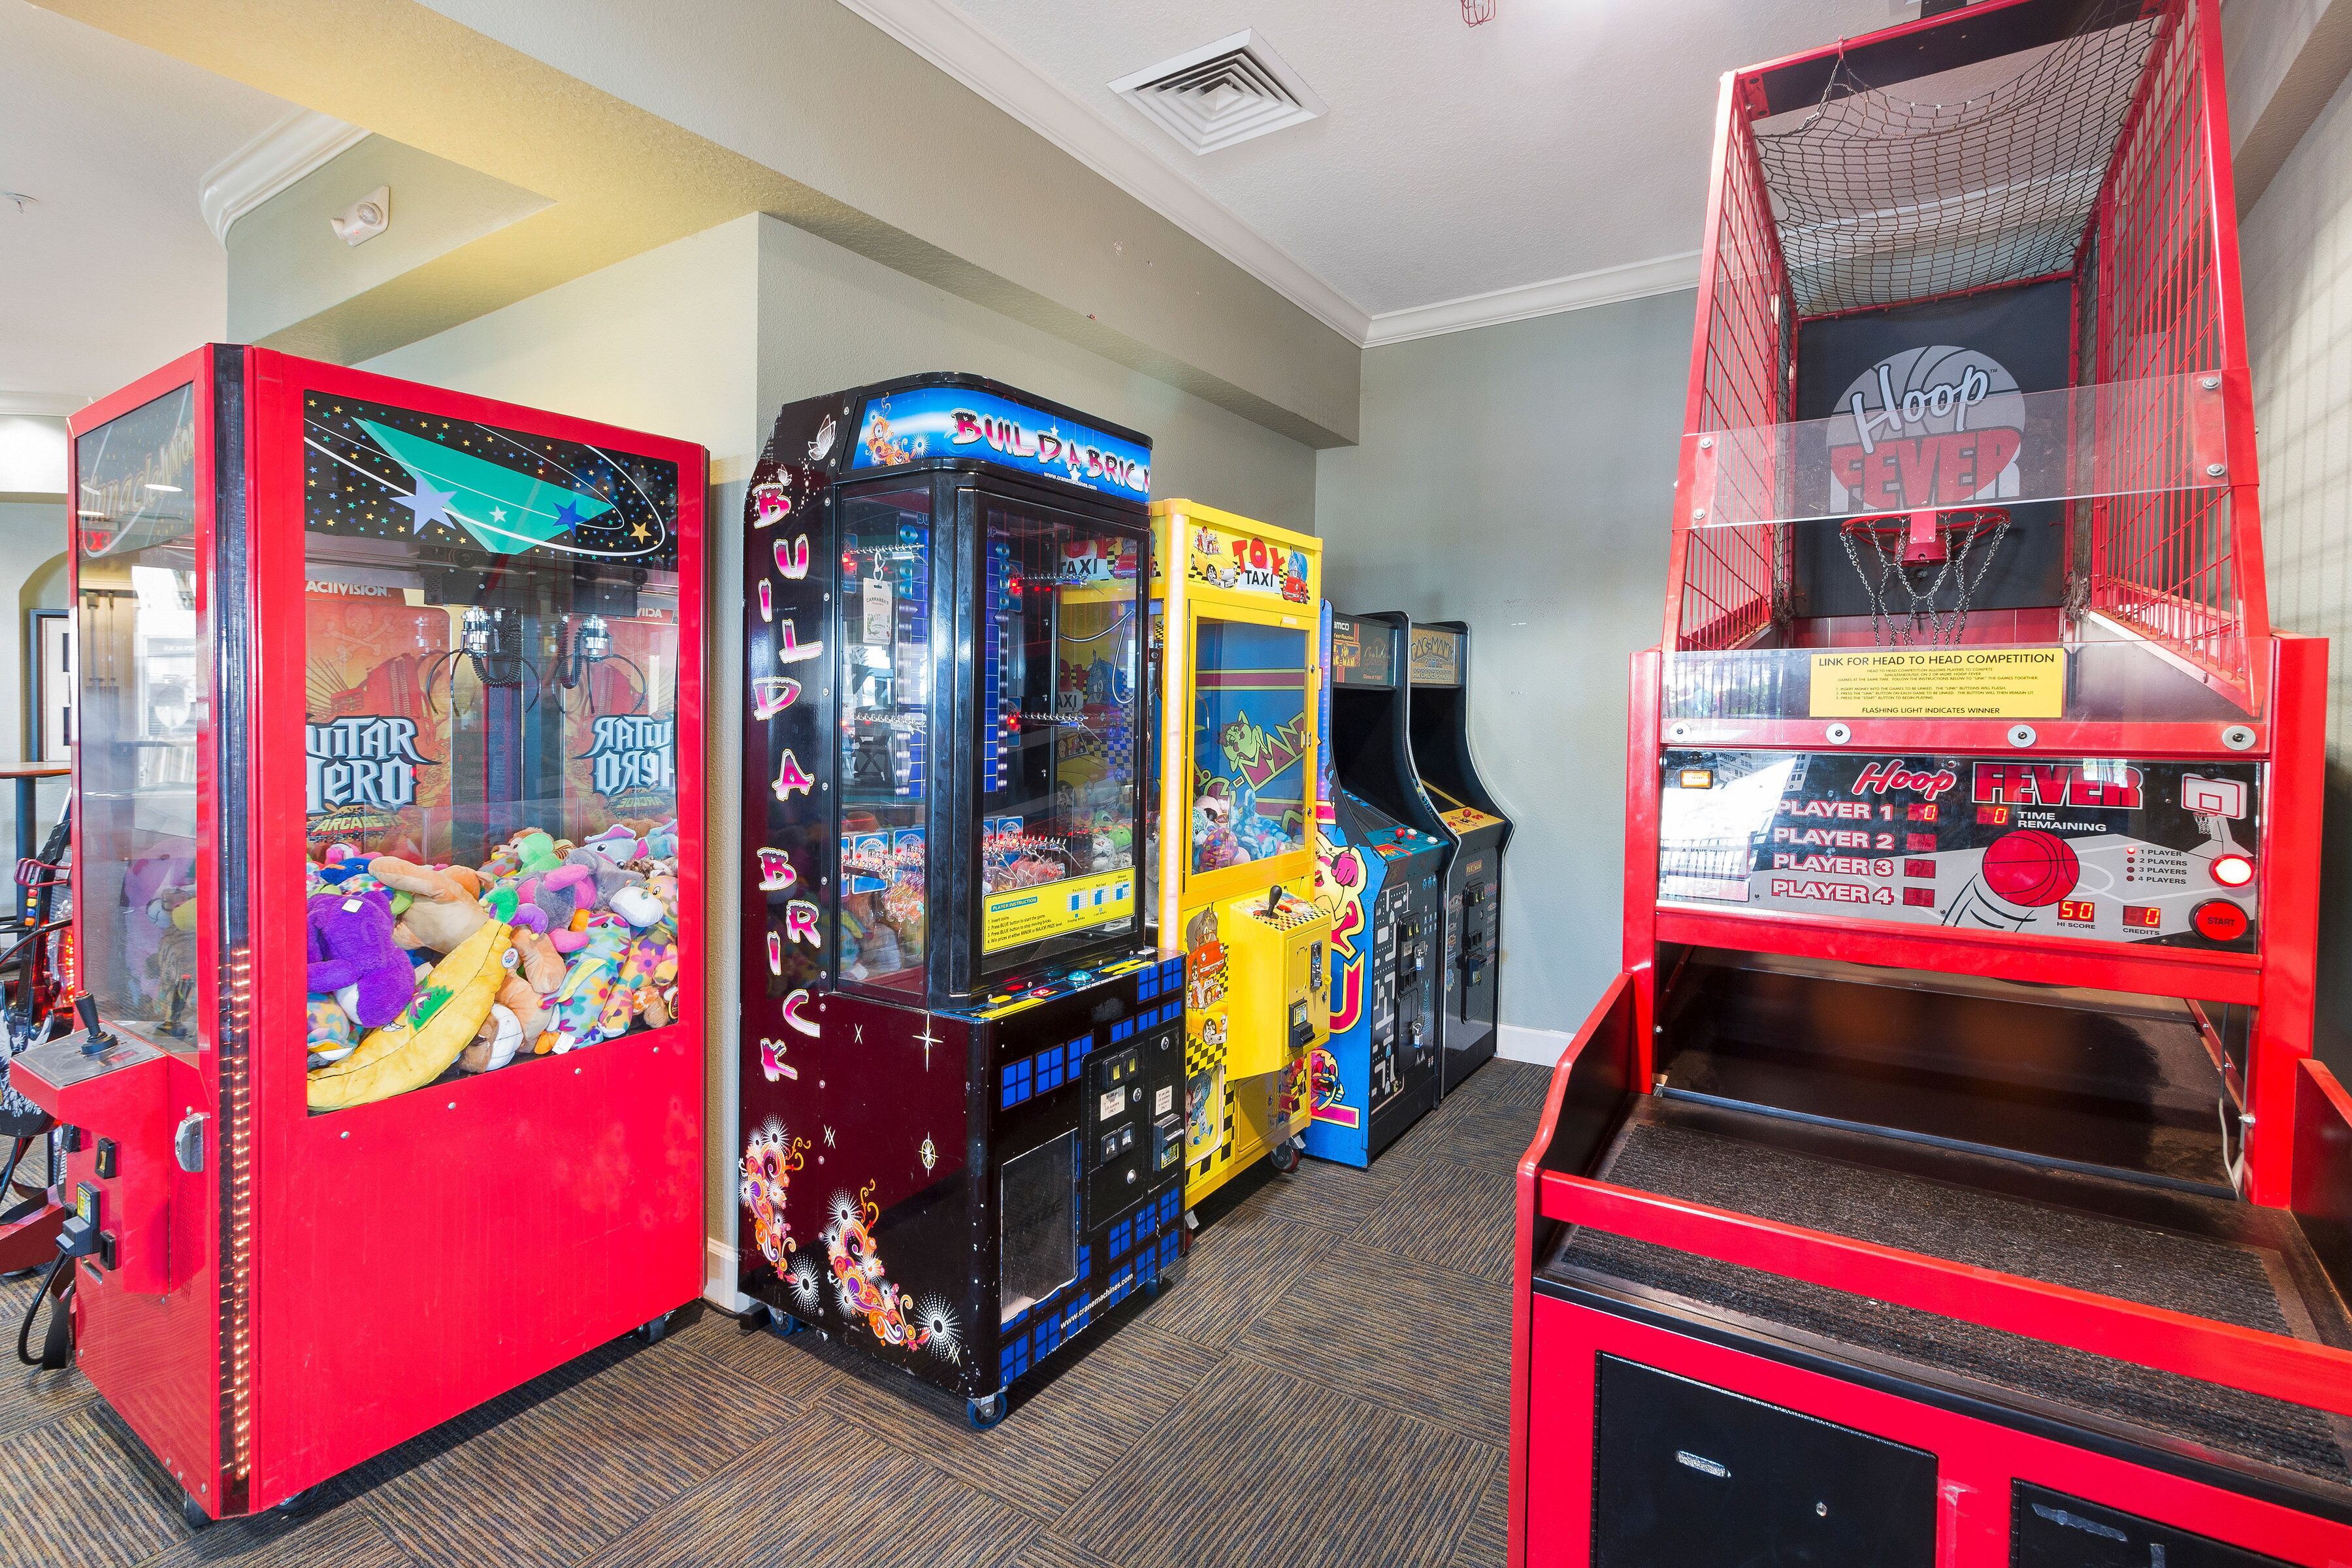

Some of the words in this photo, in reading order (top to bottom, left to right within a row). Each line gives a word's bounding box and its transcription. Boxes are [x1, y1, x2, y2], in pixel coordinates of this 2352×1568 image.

[1850, 365, 1990, 454] Hoop
[951, 408, 1062, 463] BUILD
[1066, 439, 1081, 470] A
[1829, 427, 2021, 514] FEVER
[1043, 471, 1098, 491] www.cranemachines.com
[1232, 537, 1285, 577] TOY
[1245, 570, 1273, 587] TAXI
[1333, 622, 1350, 631] amco
[1819, 657, 1843, 666] LINK
[1847, 657, 1869, 666] FOR
[1872, 657, 1904, 665] HEAD
[1908, 656, 1925, 665] TO
[1929, 655, 1962, 664] HEAD
[1966, 654, 2054, 664] COMPETITION
[306, 717, 438, 764] UITAR
[772, 749, 815, 801] A
[1851, 759, 1957, 802] Hoop
[1971, 762, 2143, 809] FEVER
[1775, 800, 1871, 820] PLAYER
[1879, 804, 1893, 821] 1
[1923, 804, 1936, 820] 0
[1995, 808, 2007, 824] 0
[2017, 811, 2055, 821] TIME
[2017, 820, 2106, 832] REMAINING
[1773, 828, 1870, 849] PLAYER
[1876, 832, 1895, 850] 2
[1773, 853, 1870, 875] PLAYER
[1874, 858, 1894, 877] 3
[2147, 867, 2187, 875] PLAYERS
[2146, 876, 2186, 885] PLAYERS
[1772, 879, 1870, 904] PLAYER
[1872, 887, 1894, 906] 4
[1008, 897, 1037, 907] INSTRUCTION
[2061, 902, 2093, 919] 50
[2145, 908, 2160, 924] 0
[2207, 917, 2235, 926] START
[1060, 1273, 1134, 1329] www.cranemachines.com
